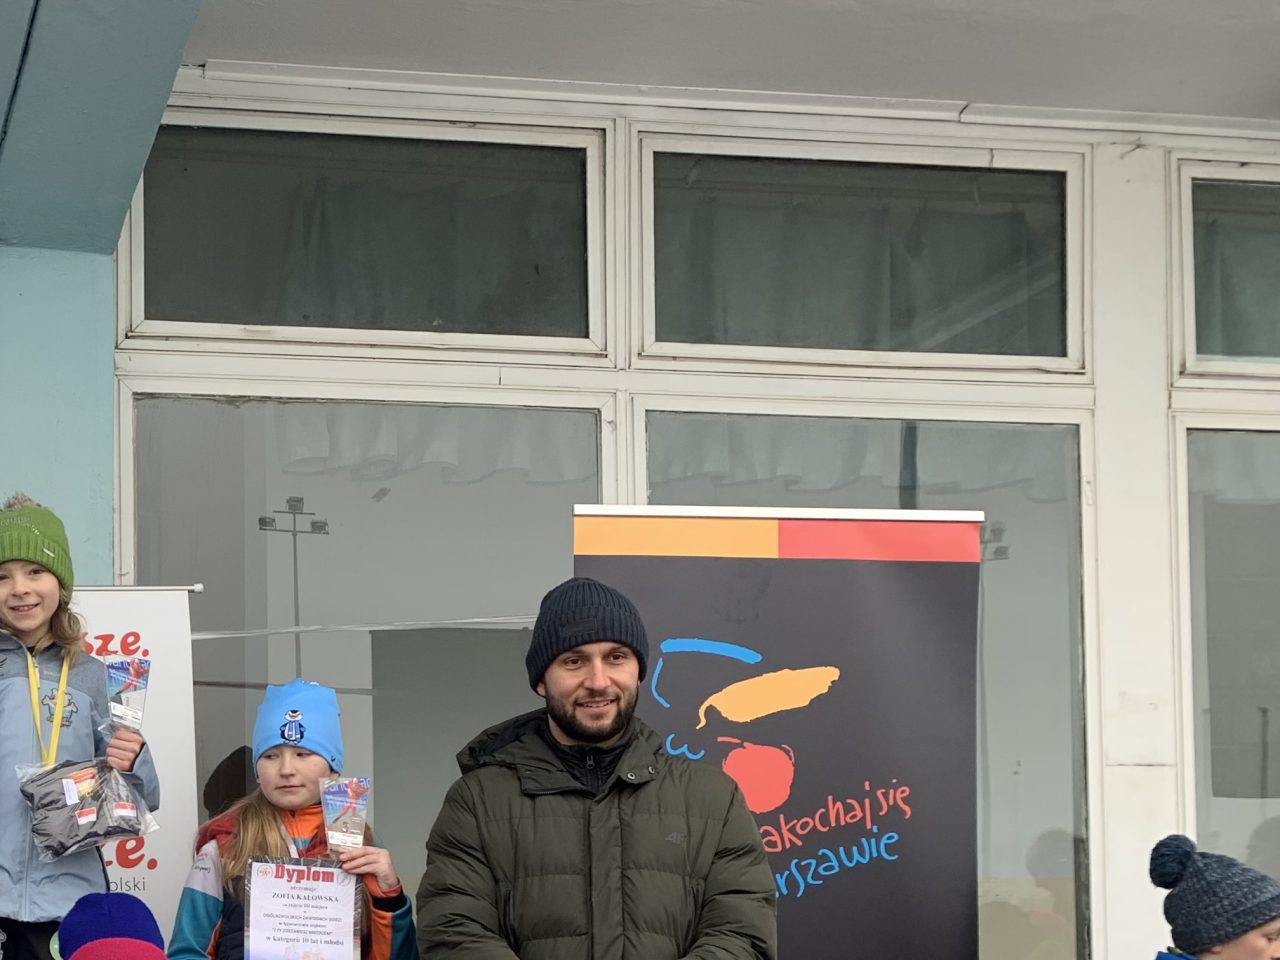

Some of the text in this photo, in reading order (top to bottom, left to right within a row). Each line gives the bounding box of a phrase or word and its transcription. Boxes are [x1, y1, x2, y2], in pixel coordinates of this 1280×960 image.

[760, 779, 912, 853] akochaj się
[110, 876, 146, 892] olski
[275, 864, 334, 883] Dyplom
[775, 825, 899, 898] rszawie
